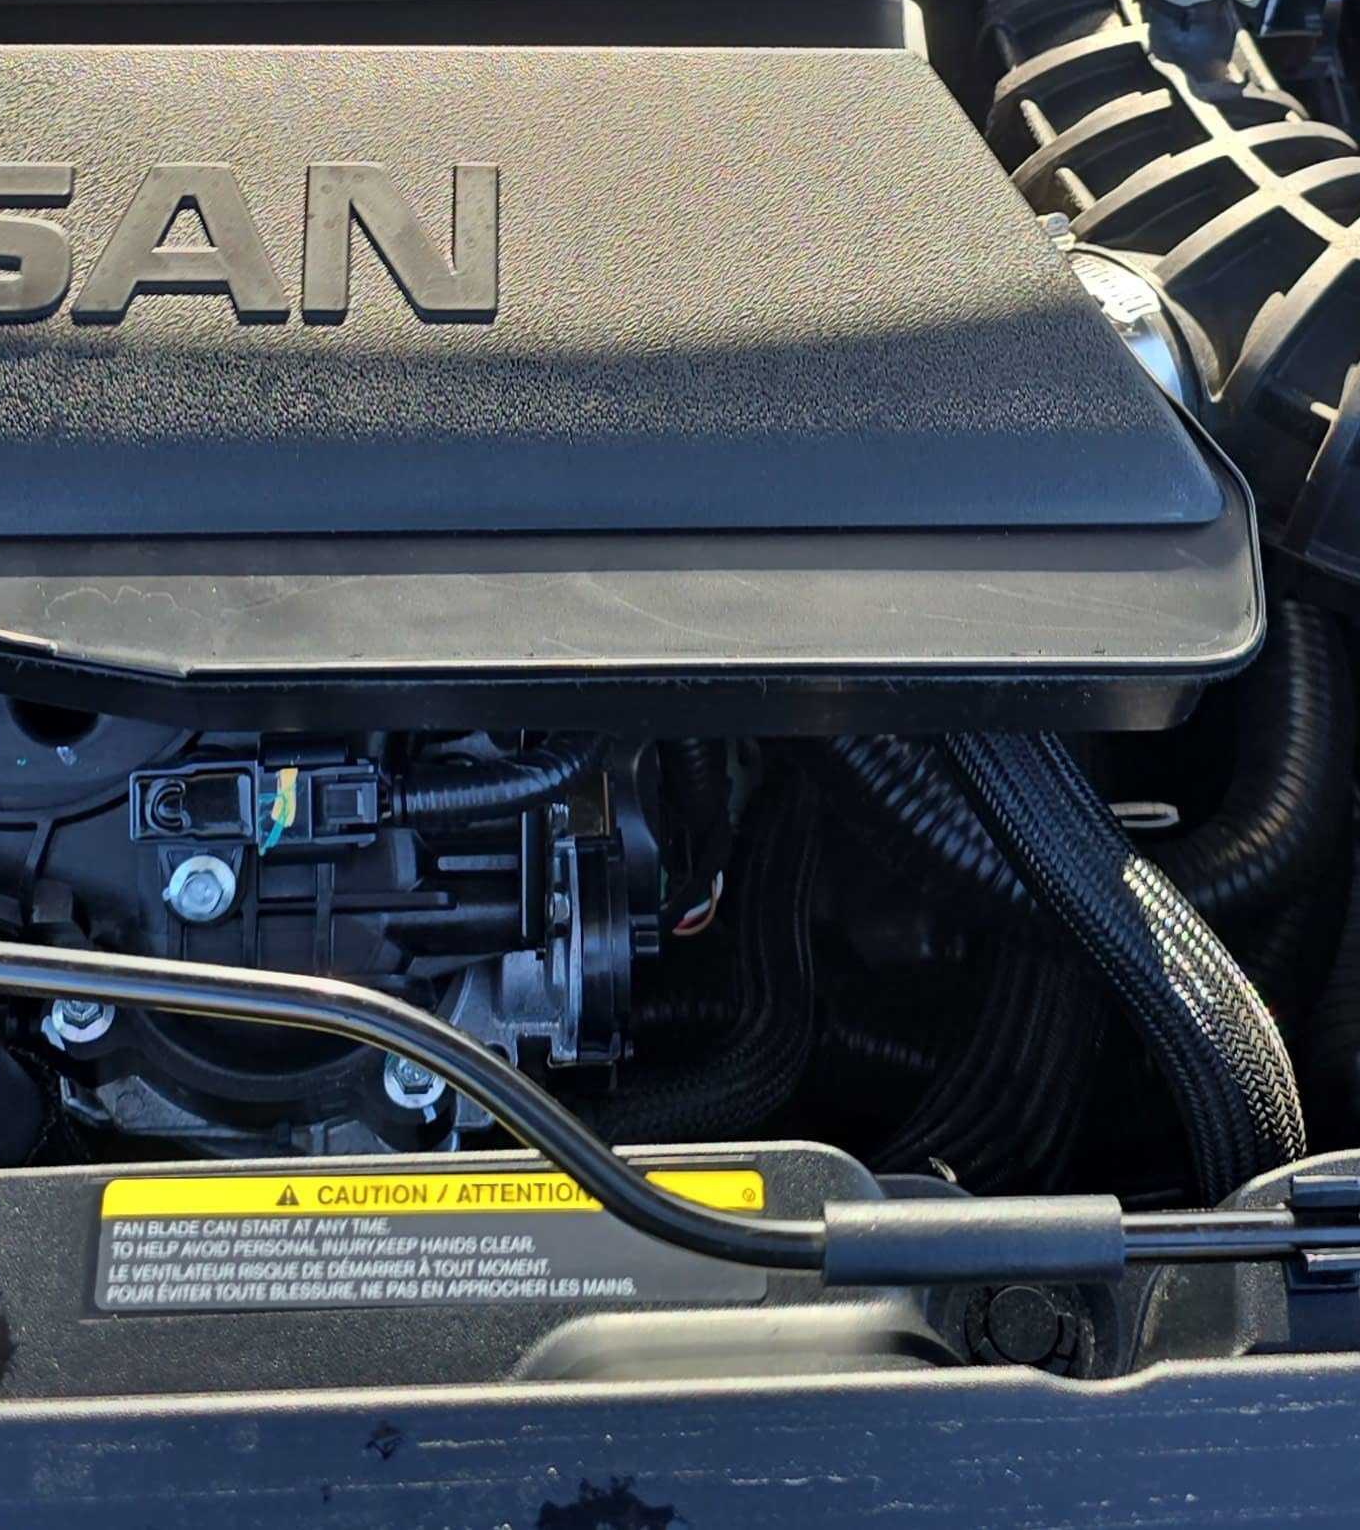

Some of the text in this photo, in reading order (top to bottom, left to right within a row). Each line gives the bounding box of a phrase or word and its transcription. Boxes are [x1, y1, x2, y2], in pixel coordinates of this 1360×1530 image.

[317, 1184, 427, 1205] CAUTION
[437, 1184, 448, 1204] /
[114, 1221, 143, 1237] FAN
[147, 1220, 199, 1236] BLADE
[203, 1220, 236, 1236] CAN
[241, 1219, 289, 1235] START
[293, 1219, 312, 1234] AT
[315, 1218, 345, 1234] ANY
[111, 1241, 133, 1259] TO
[137, 1241, 179, 1258] HELP
[180, 1241, 229, 1257] AVOID
[234, 1239, 318, 1257] PERSONAL
[420, 1237, 476, 1254] HANDS
[108, 1264, 130, 1283] LE
[132, 1262, 236, 1282] VENTILATEUR
[239, 1262, 298, 1281] RISQUE
[302, 1262, 324, 1280] DE
[327, 1256, 415, 1279] DÉMARRER
[431, 1260, 475, 1277] TOUT
[107, 1277, 637, 1303] POUR ÉVITER TOUTE BLESSURE, NE PAS EN APPROCHER LES MAINS.
